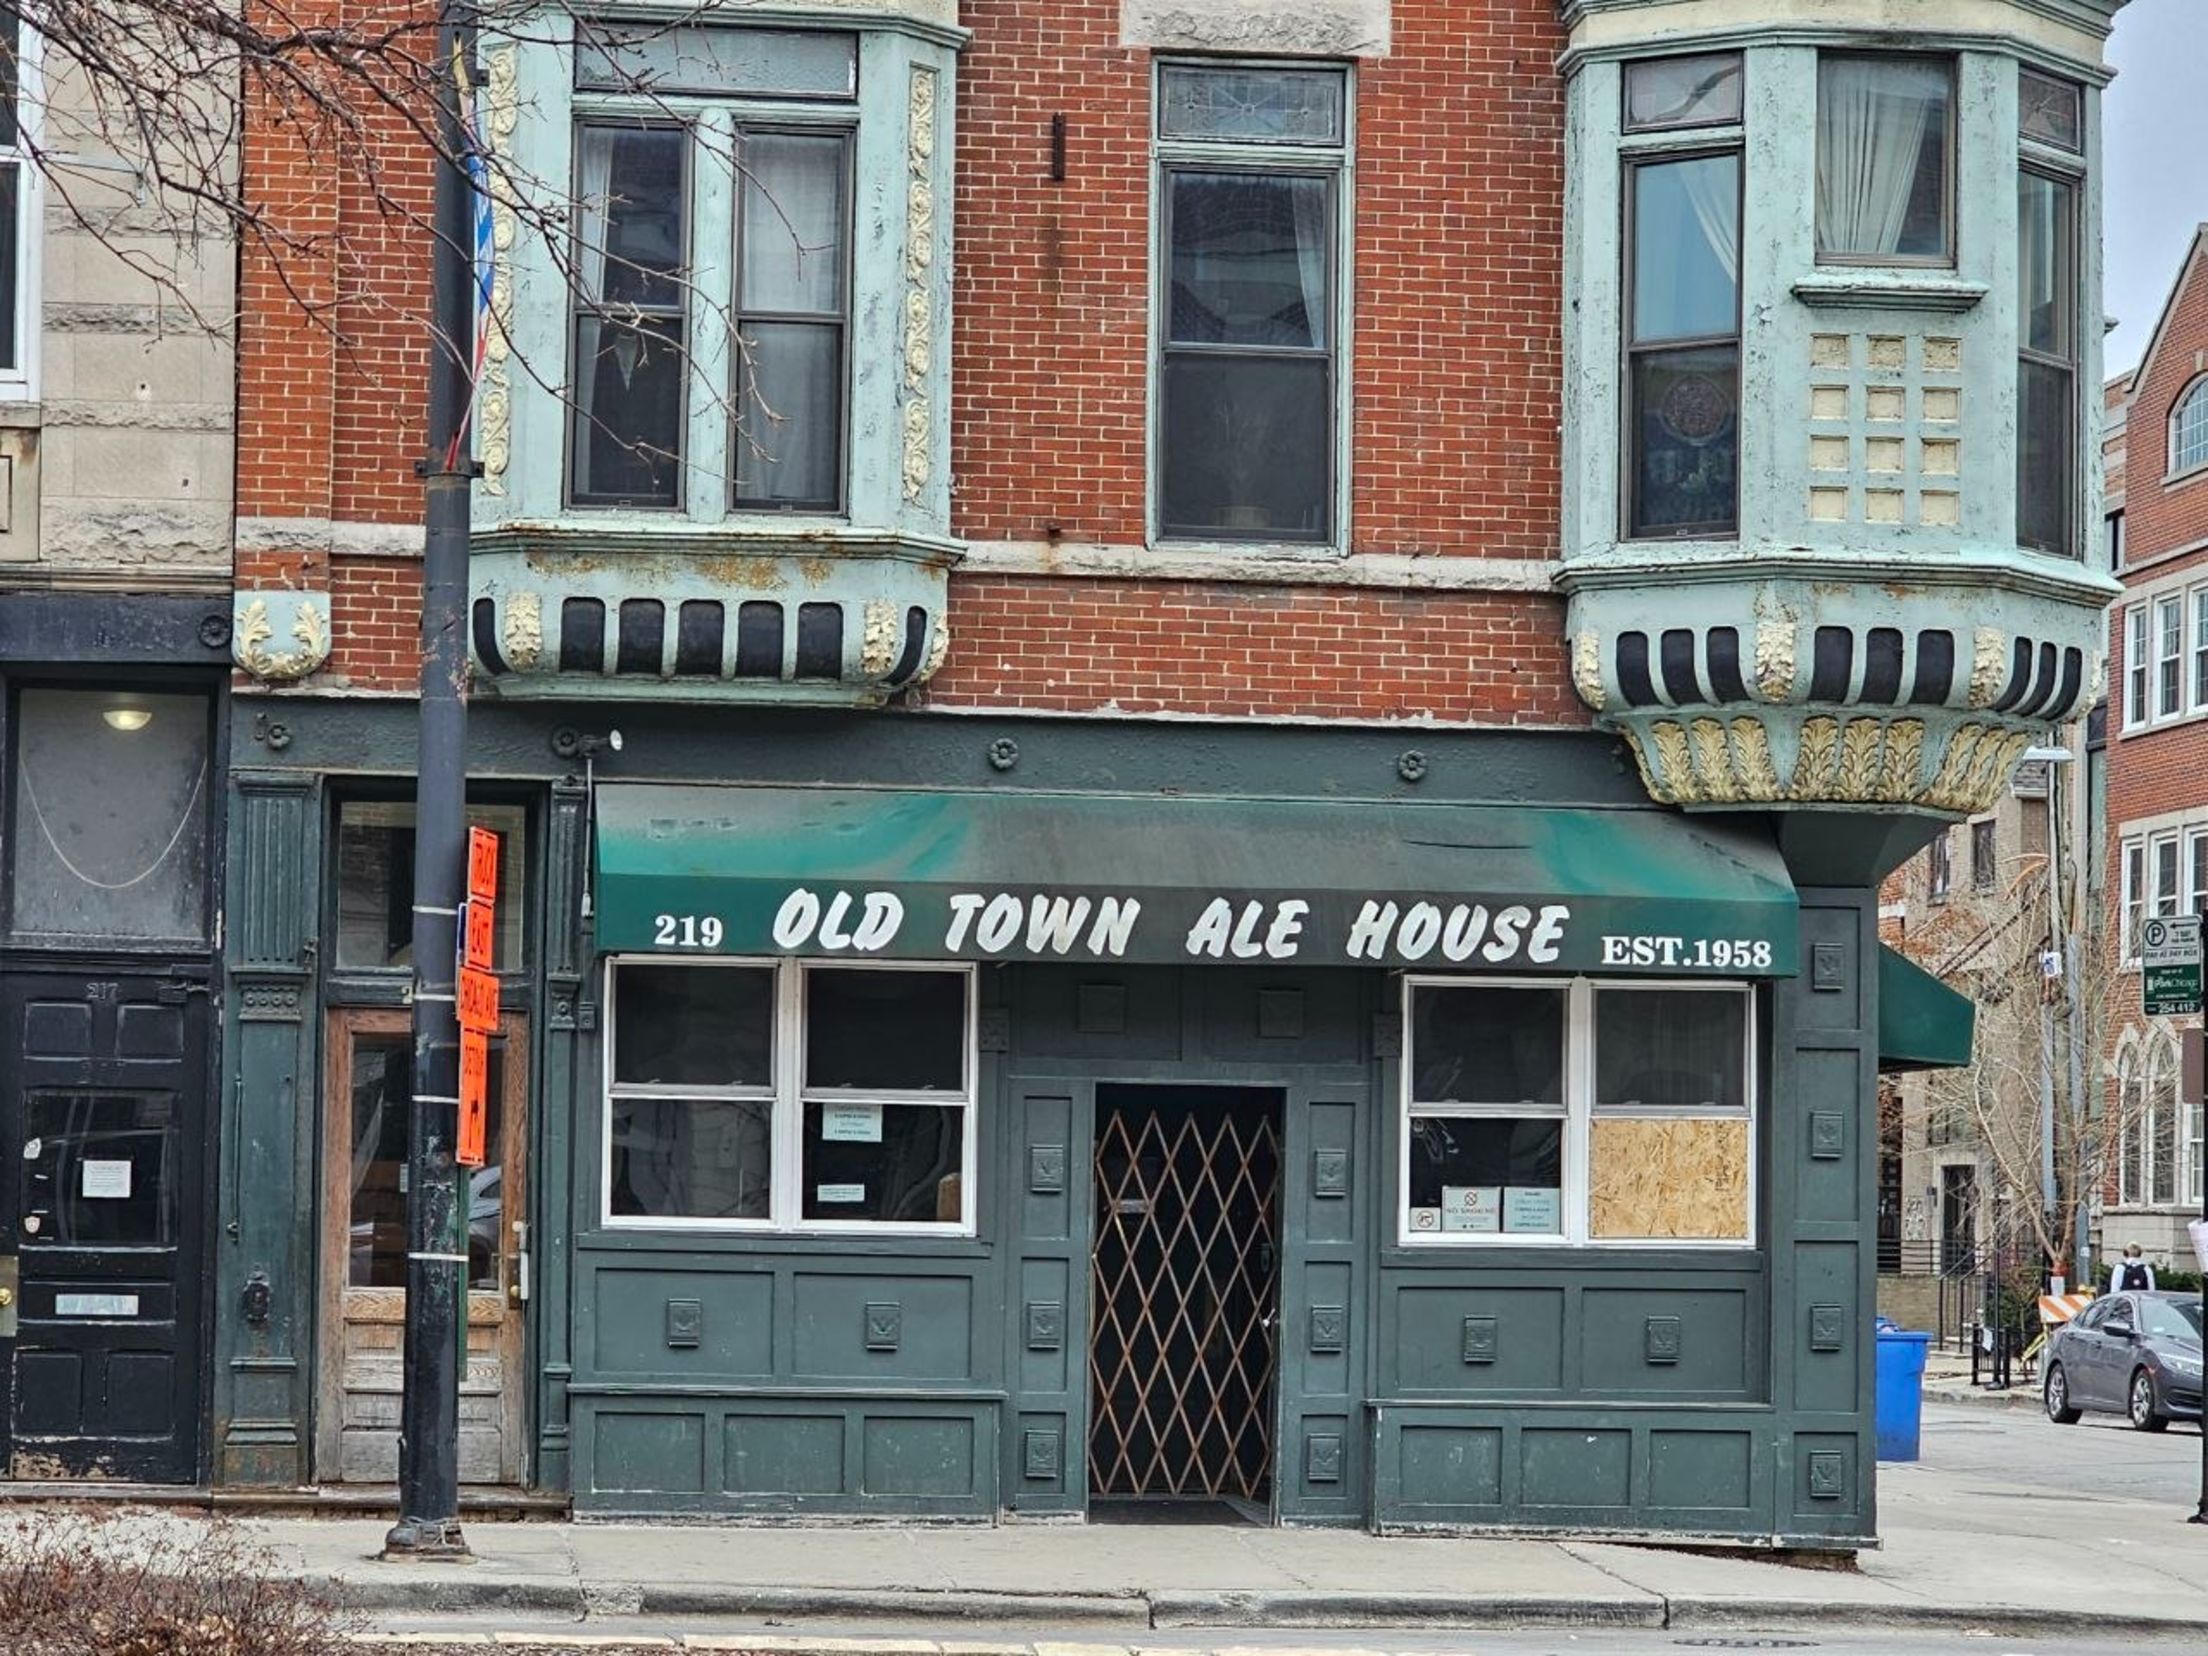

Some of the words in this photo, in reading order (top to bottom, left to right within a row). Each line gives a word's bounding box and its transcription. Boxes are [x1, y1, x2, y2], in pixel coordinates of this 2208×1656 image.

[654, 915, 723, 948] 219
[772, 887, 904, 951] OLD
[945, 894, 1141, 956] TOWN
[1186, 897, 1310, 959] ALE
[1346, 900, 1570, 964] HOUSE
[1601, 936, 1773, 969] EST.1958
